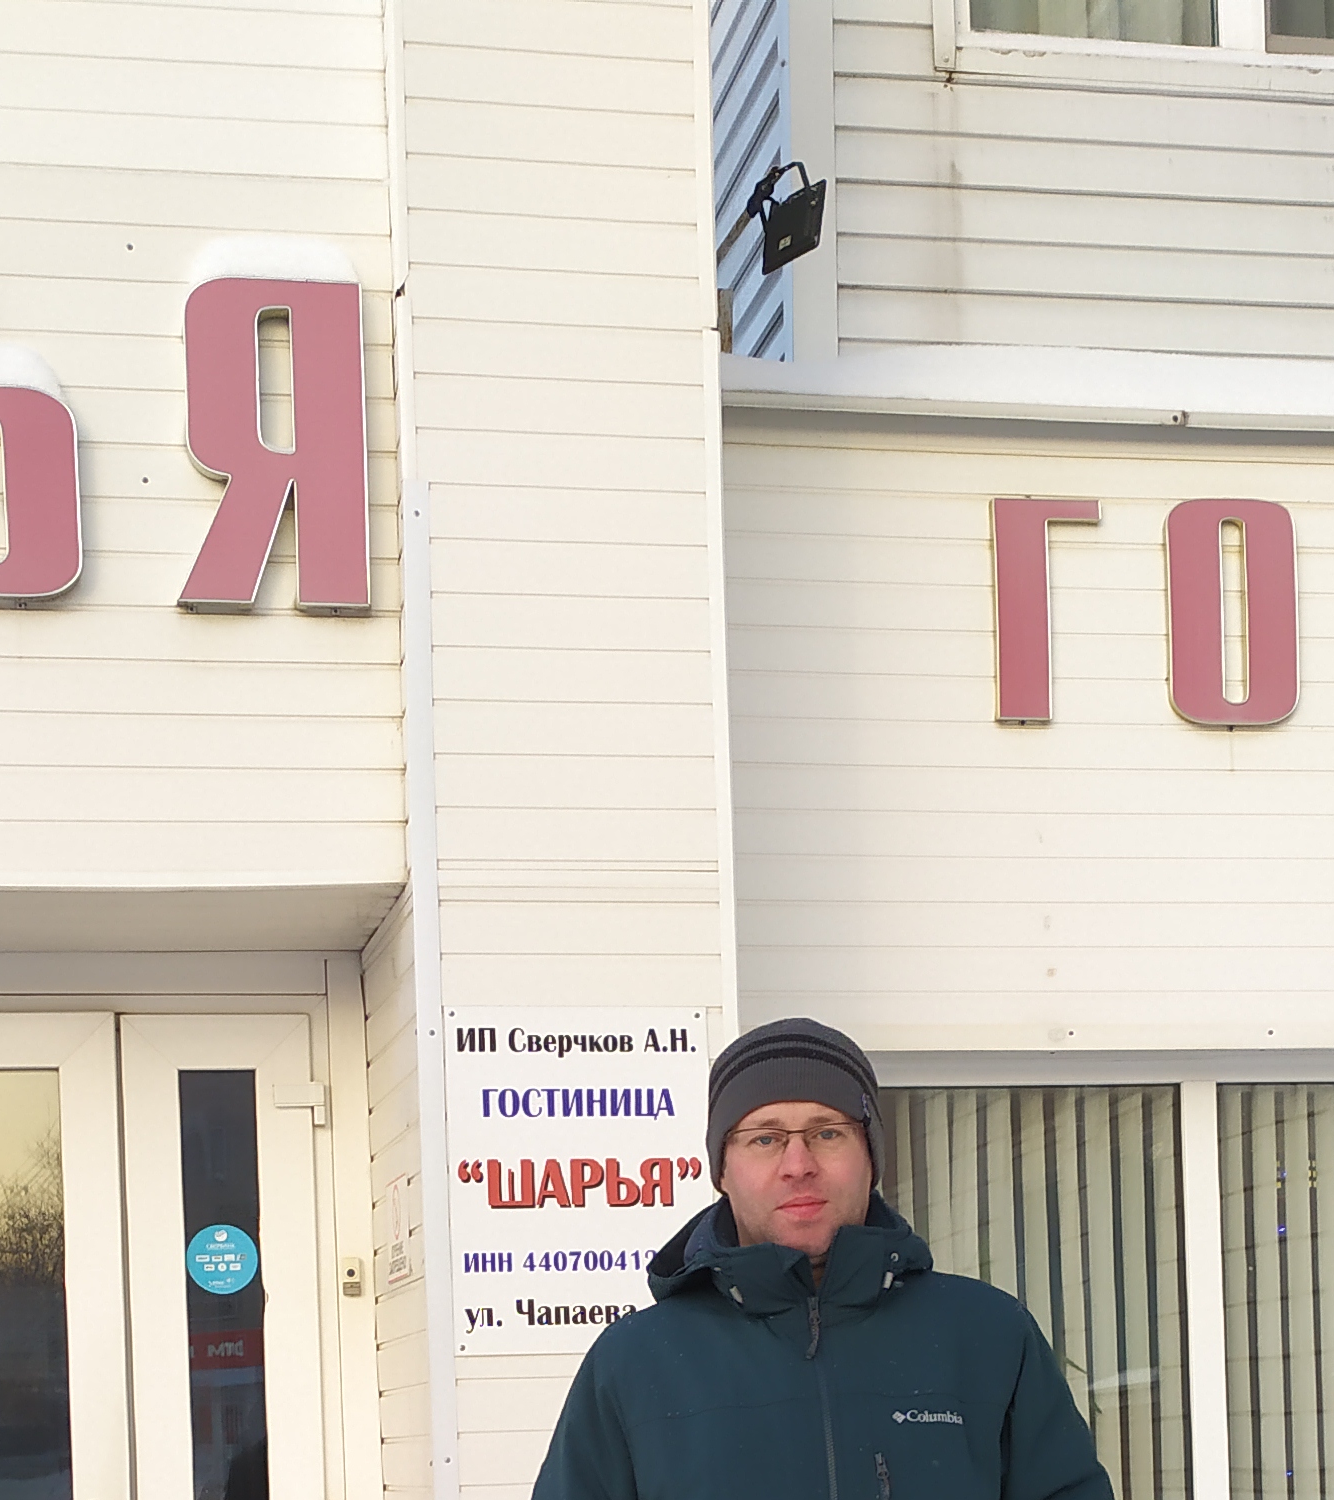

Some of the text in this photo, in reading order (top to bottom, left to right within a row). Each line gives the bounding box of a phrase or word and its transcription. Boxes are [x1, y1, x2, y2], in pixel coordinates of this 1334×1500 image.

[456, 1027, 698, 1059] ИП Сверчков А.Н.
[481, 1087, 676, 1121] ГОСТИНИЦА
[463, 1252, 513, 1274] ИНН
[464, 1307, 503, 1334] ул.
[905, 1409, 964, 1425] Columbia
